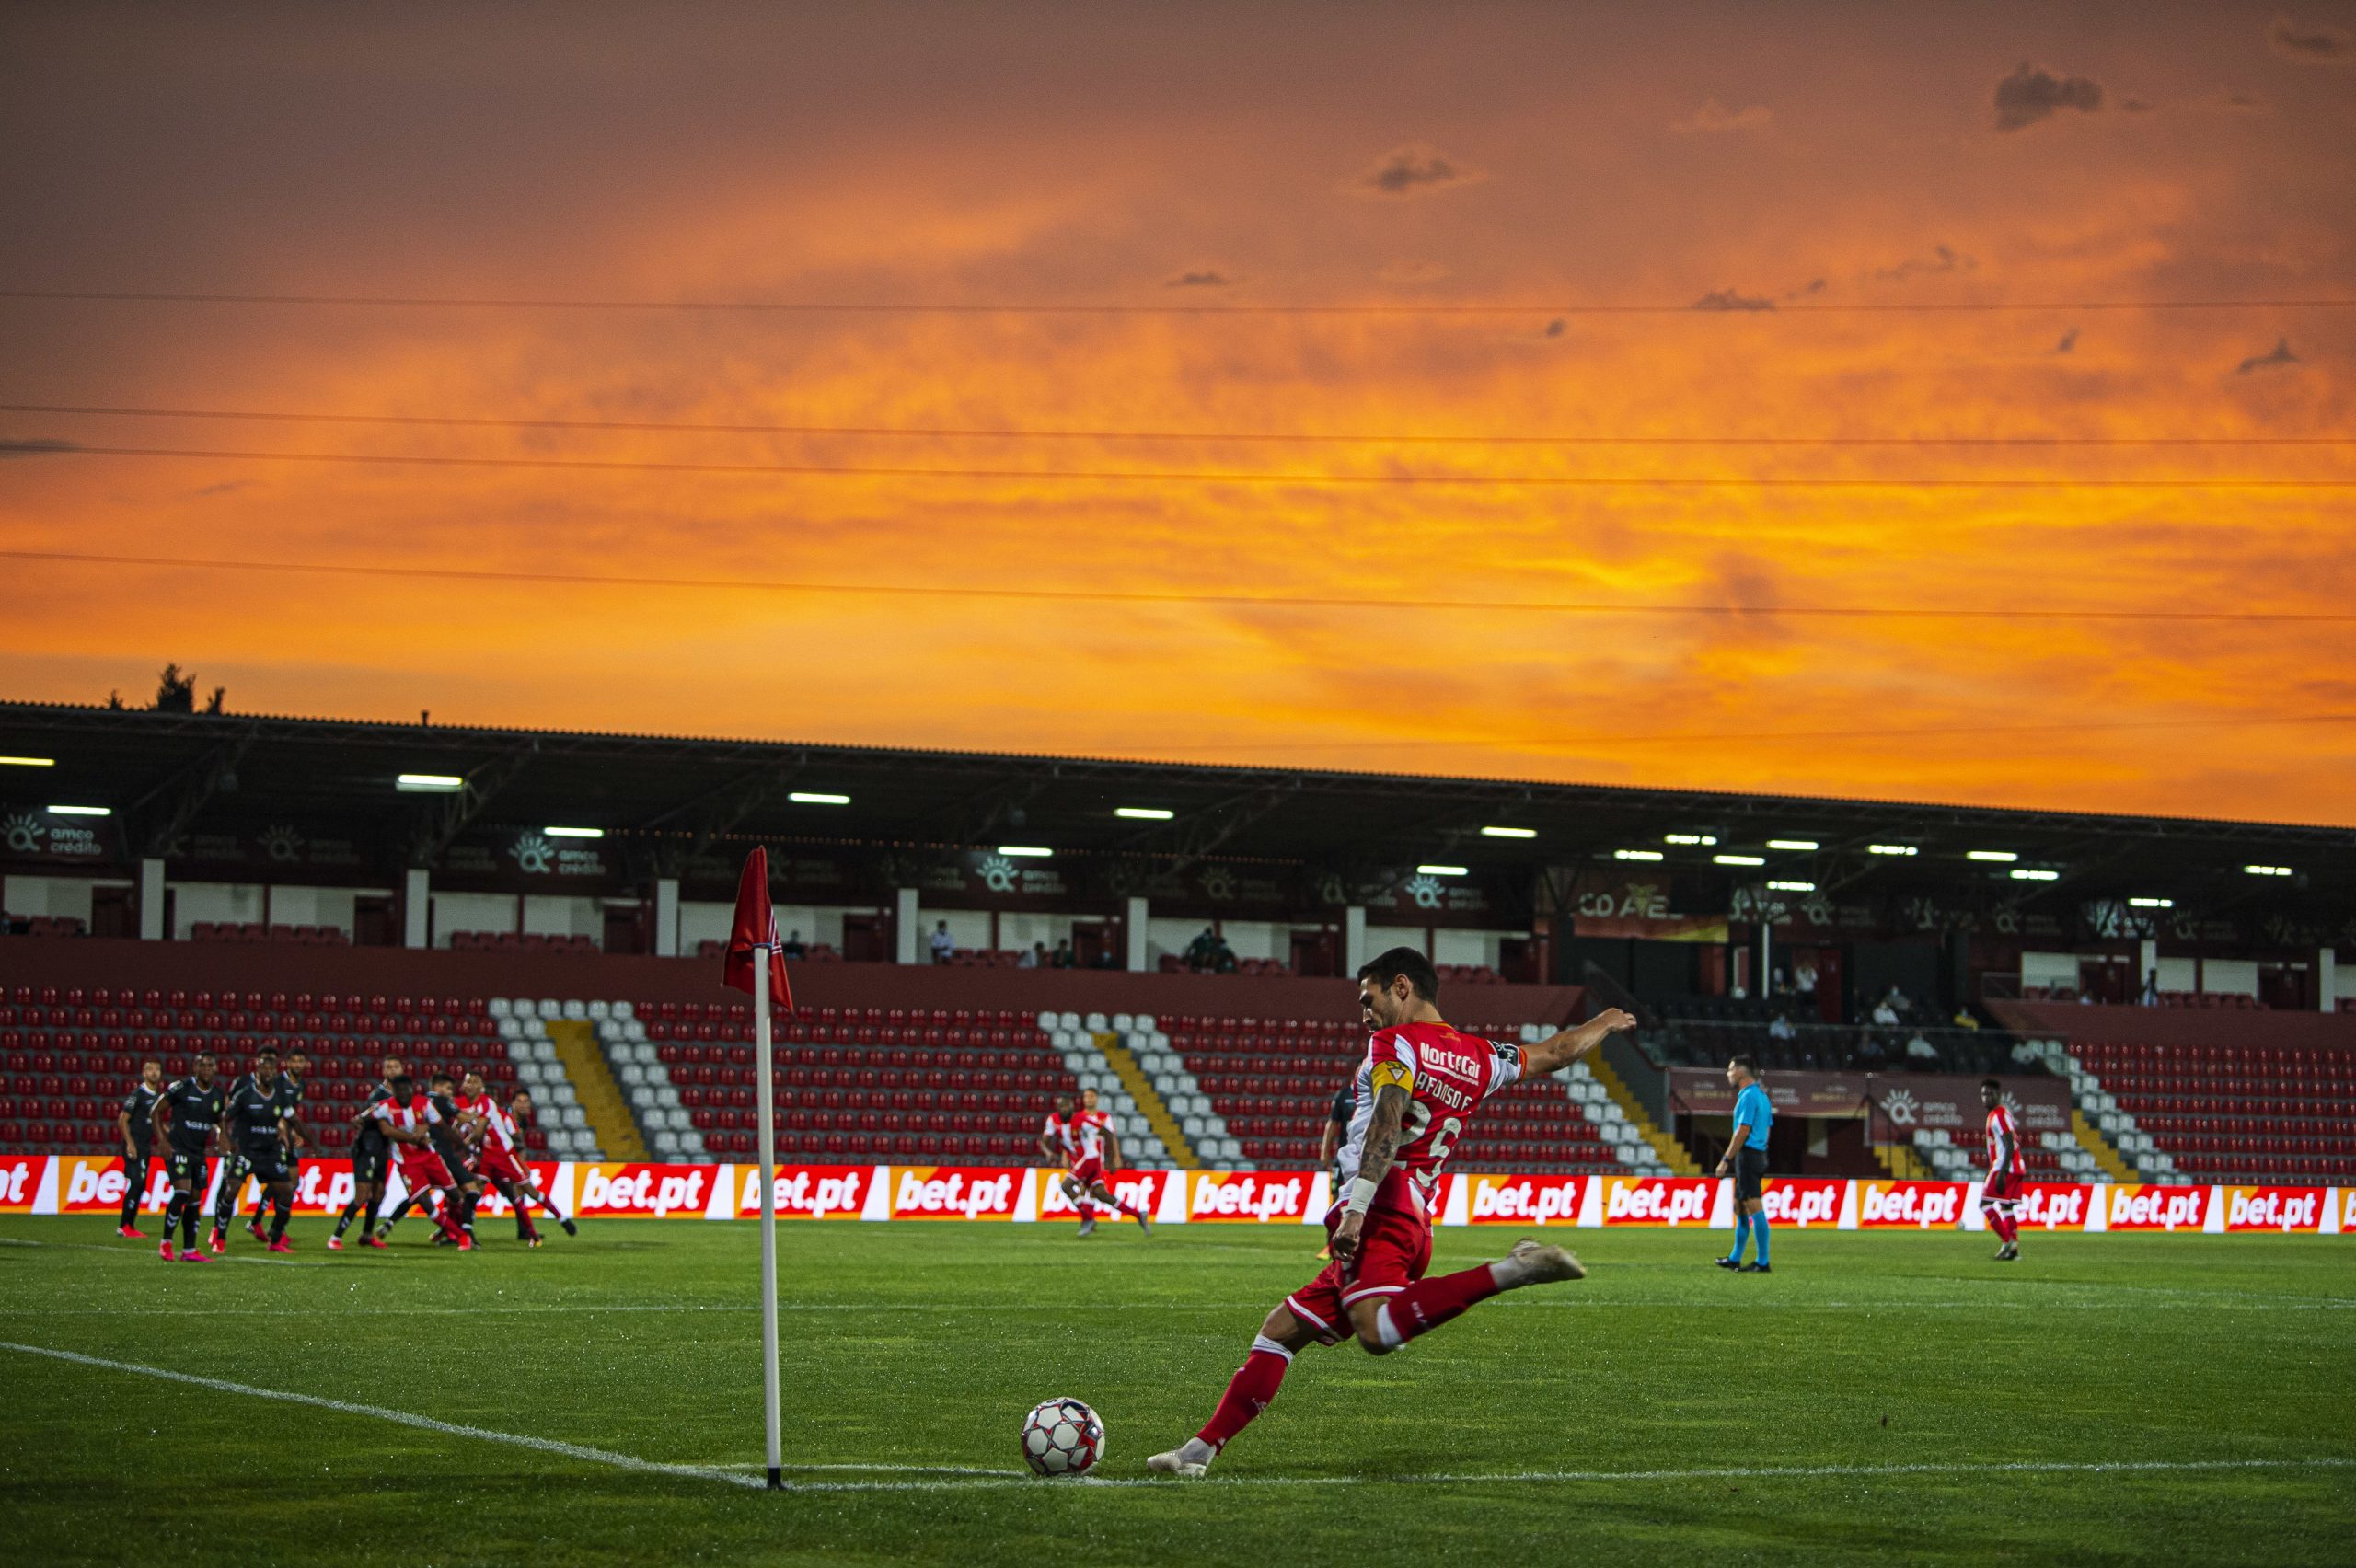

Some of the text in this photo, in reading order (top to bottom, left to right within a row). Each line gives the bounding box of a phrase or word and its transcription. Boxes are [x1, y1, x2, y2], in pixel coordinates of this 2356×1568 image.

[67, 1161, 175, 1213] be.p
[580, 1167, 704, 1218] bet.pt
[741, 1169, 860, 1219] bet.pt
[895, 1170, 1011, 1220] bet.pt
[1042, 1172, 1155, 1222] bpt
[1193, 1175, 1301, 1223] bet.pt
[1473, 1179, 1576, 1226] bet.pt
[1607, 1180, 1707, 1227] bet.pt
[1761, 1184, 1836, 1228] et.pt
[1863, 1183, 1958, 1229] bet.pt
[2013, 1188, 2082, 1230] et.pt
[2111, 1188, 2200, 1232] bet.pt
[2229, 1190, 2316, 1232] bet.pt
